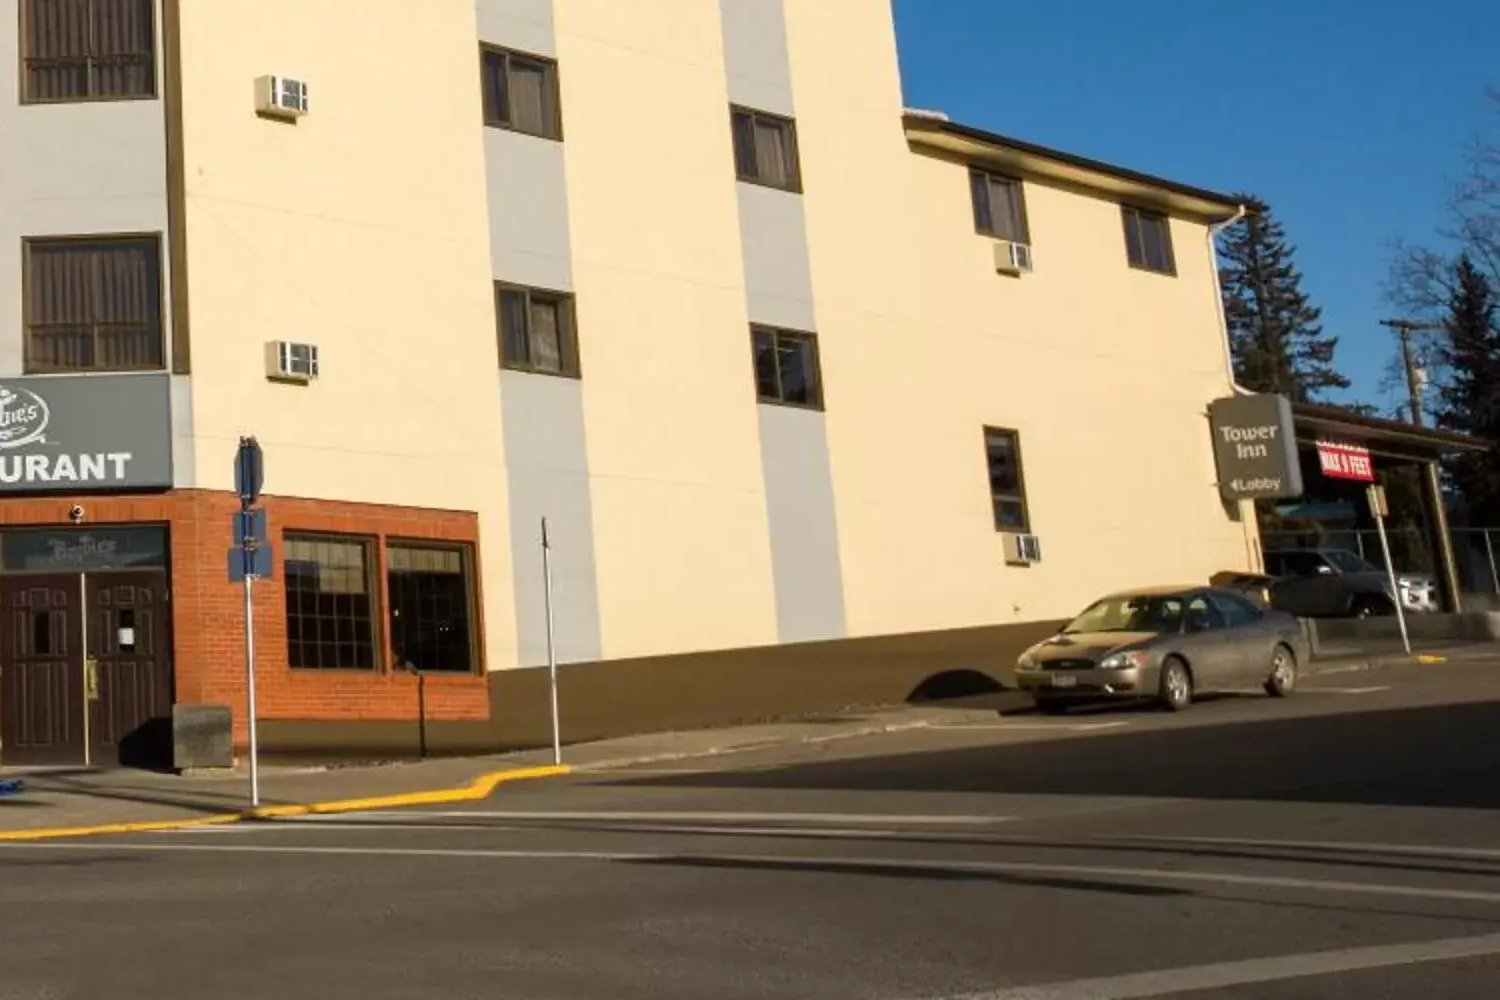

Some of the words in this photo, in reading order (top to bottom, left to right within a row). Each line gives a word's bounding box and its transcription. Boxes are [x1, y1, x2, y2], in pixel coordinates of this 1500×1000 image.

[1219, 425, 1278, 442] Tower
[1236, 443, 1268, 459] Inn
[1239, 477, 1281, 491] Lobby
